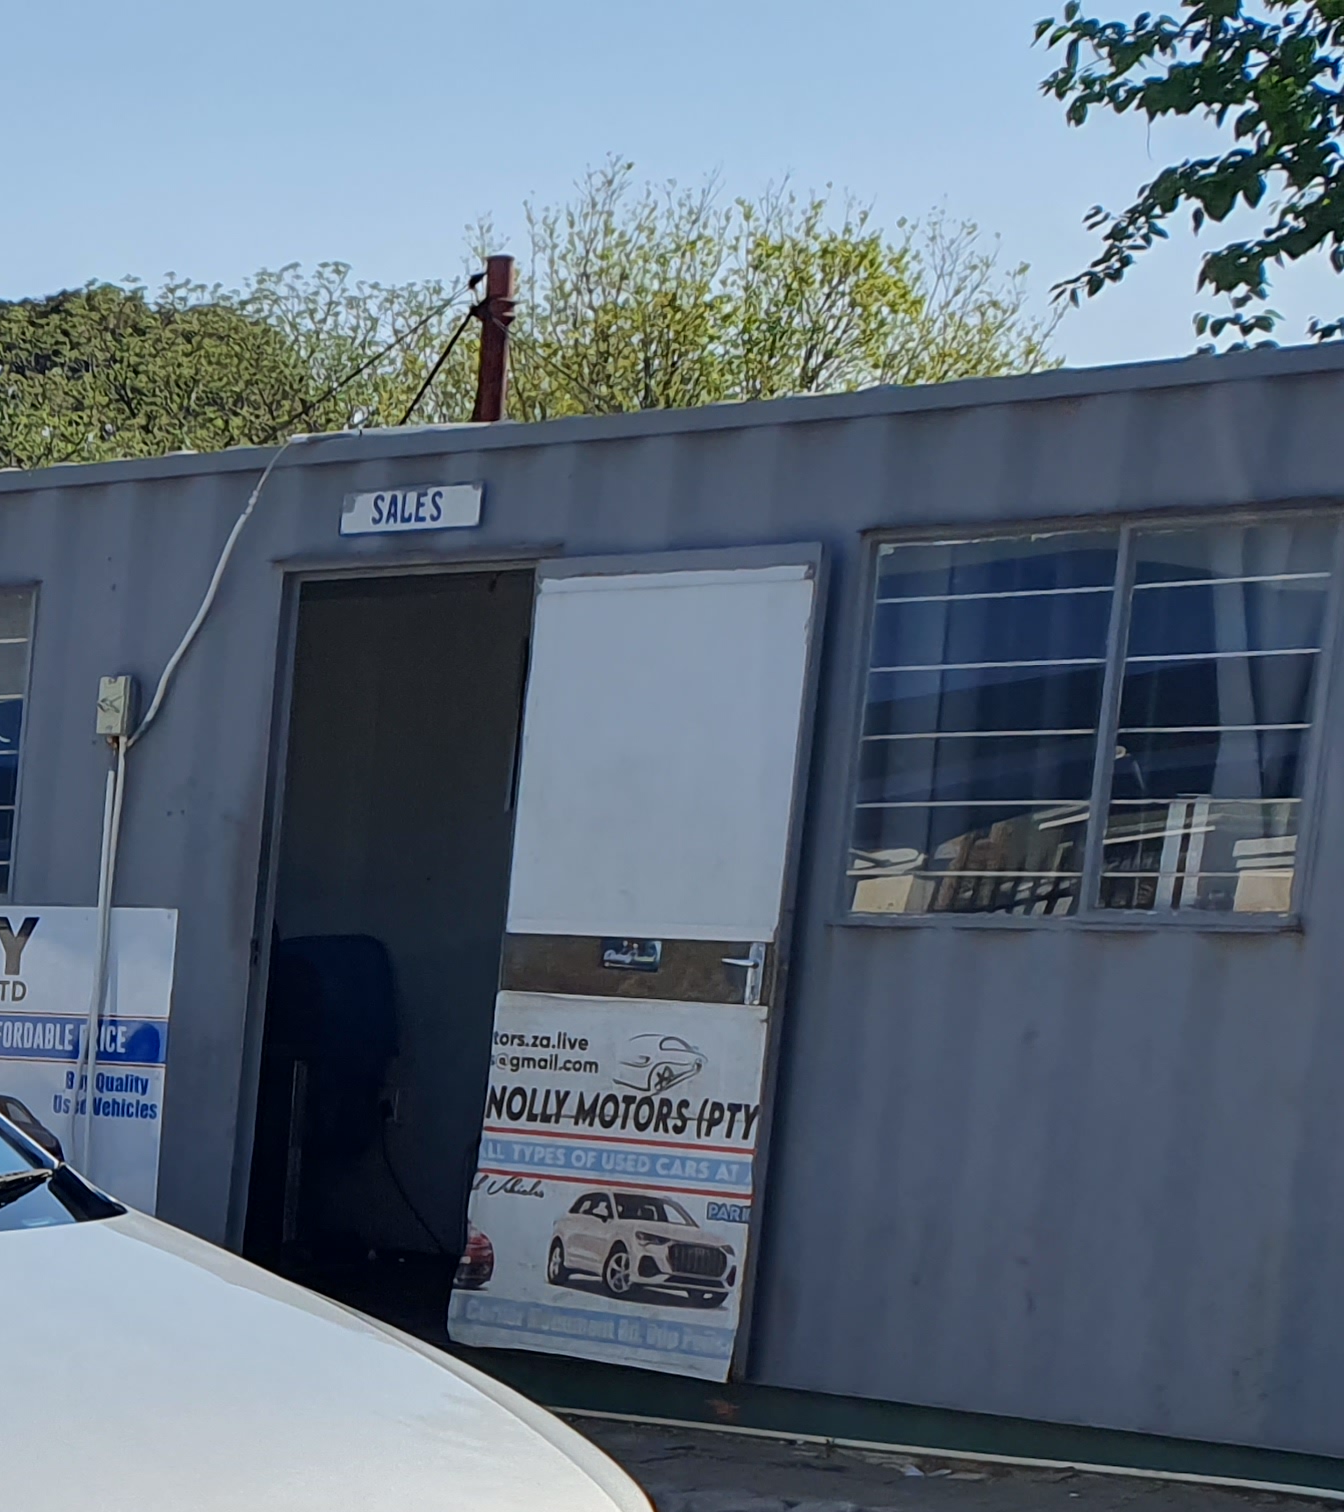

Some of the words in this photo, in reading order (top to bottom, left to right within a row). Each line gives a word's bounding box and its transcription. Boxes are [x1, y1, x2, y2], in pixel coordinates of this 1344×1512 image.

[371, 490, 443, 524] SALES
[79, 1024, 127, 1053] PICE
[95, 1072, 149, 1096] Quality
[93, 1097, 158, 1119] Vehicles
[485, 1084, 571, 1125] NOLLY
[573, 1091, 700, 1135] MOTORS
[695, 1098, 759, 1141] (PTY
[513, 1143, 563, 1165] TYPES
[571, 1149, 597, 1169] OF
[601, 1152, 649, 1173] USED
[655, 1158, 709, 1180] CARS
[715, 1162, 739, 1182] AT
